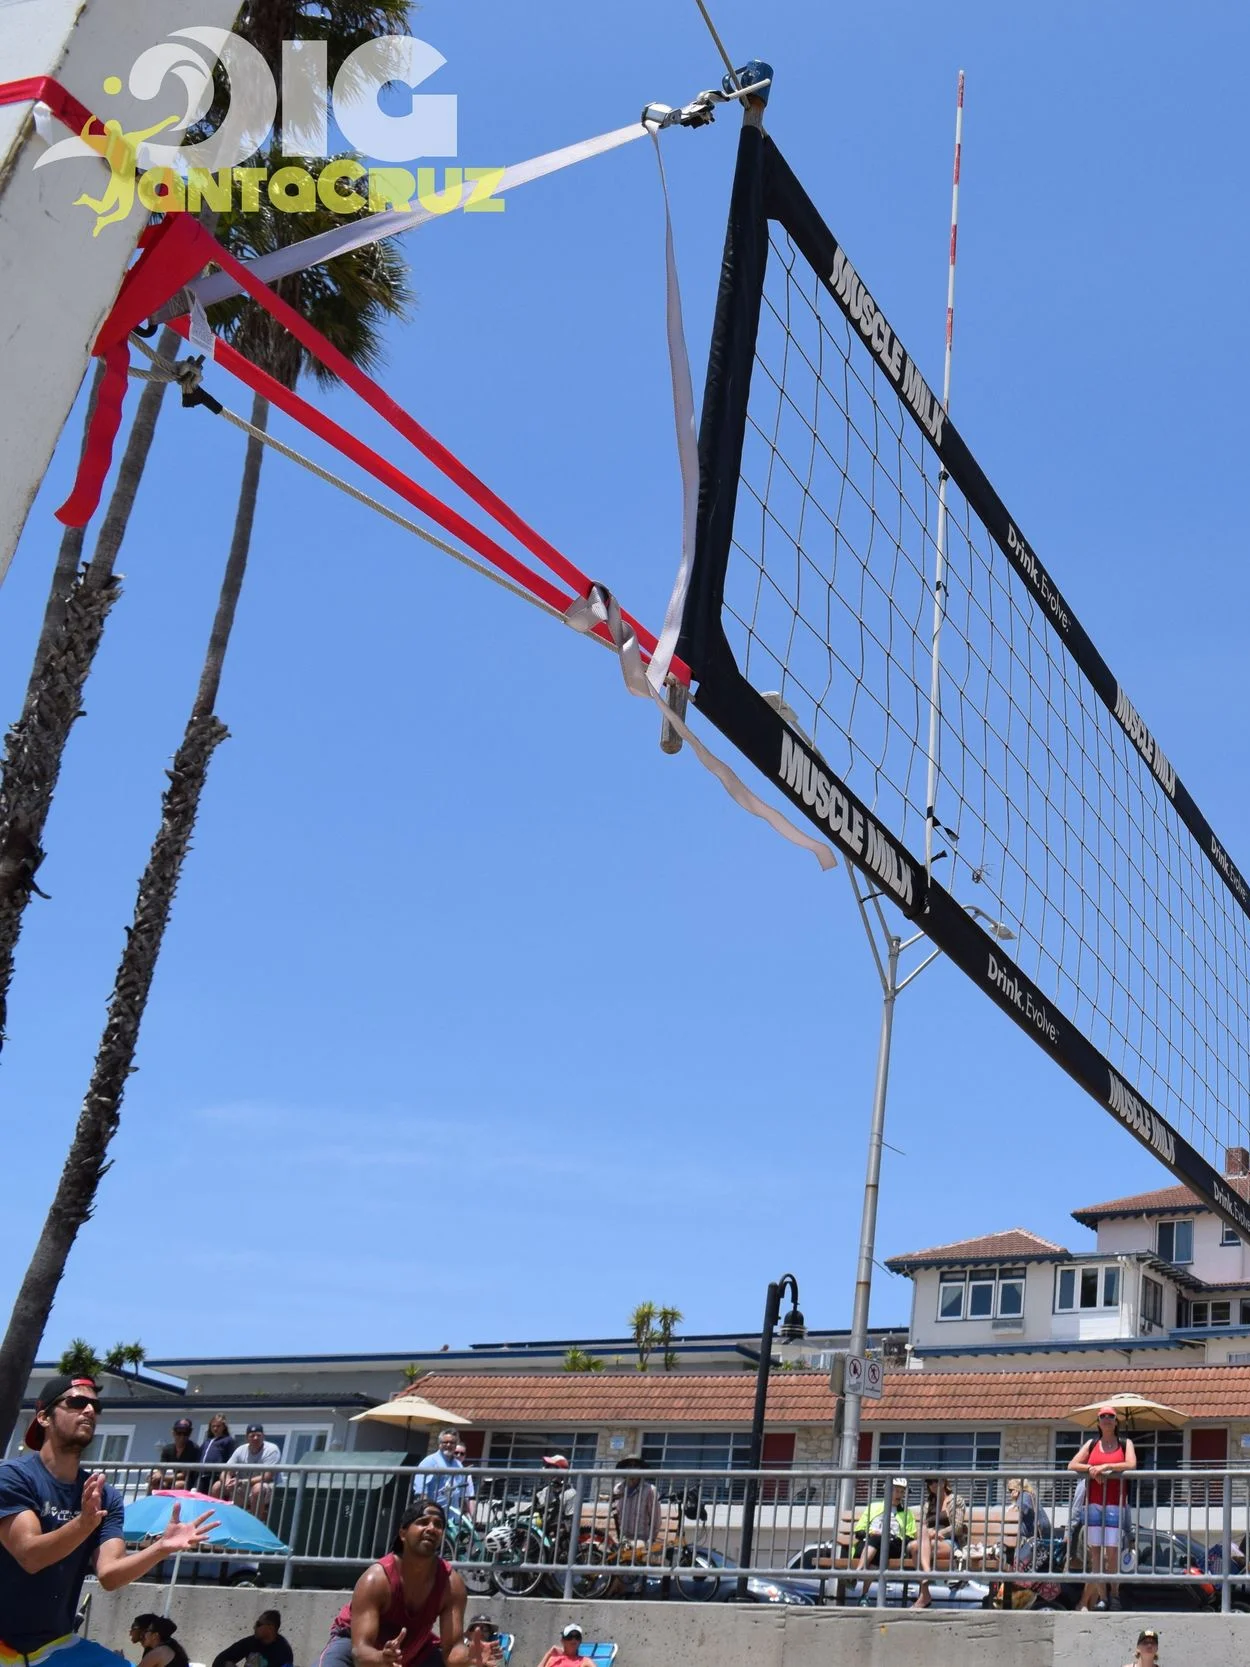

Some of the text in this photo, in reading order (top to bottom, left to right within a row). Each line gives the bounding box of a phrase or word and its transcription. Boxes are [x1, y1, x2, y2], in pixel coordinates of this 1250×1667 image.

[829, 246, 944, 446] MUSCLE MILK
[1114, 683, 1154, 764] MUSCLE
[779, 729, 913, 906] MUSCLE MILK
[1108, 1068, 1177, 1165] MUSCLE MILK
